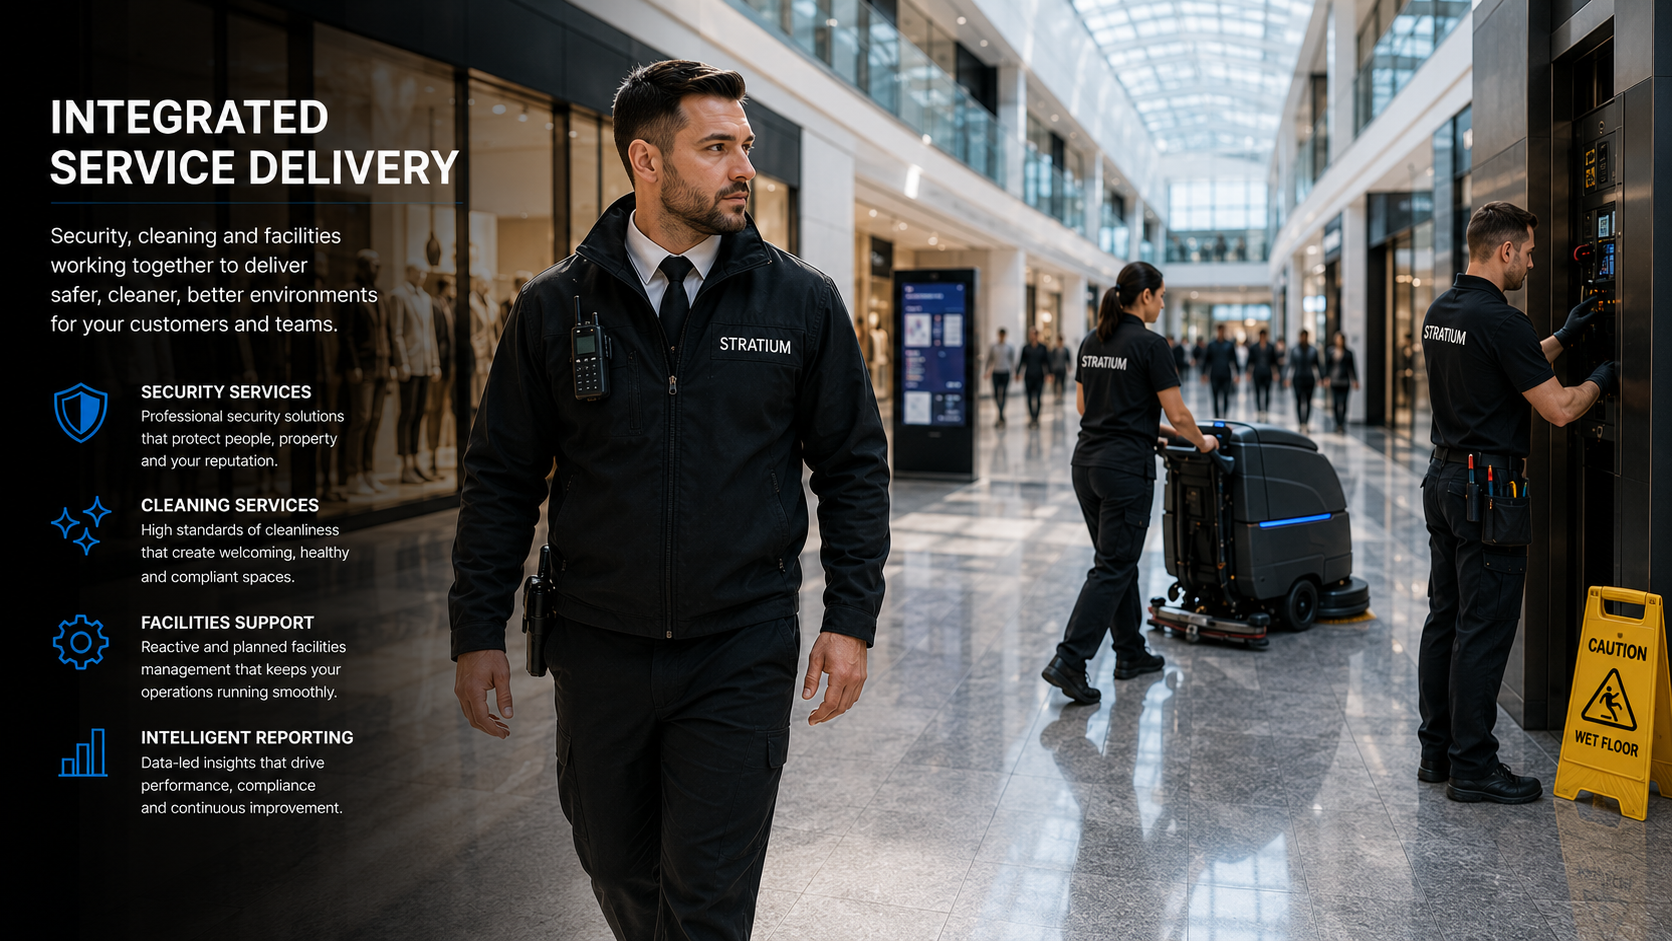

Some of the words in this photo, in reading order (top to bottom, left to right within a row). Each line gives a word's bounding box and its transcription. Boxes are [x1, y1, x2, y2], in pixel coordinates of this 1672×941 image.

[719, 336, 792, 355] STRATIUM
[1423, 324, 1467, 346] STRATIUM
[1081, 355, 1128, 371] STRATIUM
[1588, 637, 1648, 662] CAUTION
[1575, 729, 1600, 747] WET
[1601, 736, 1639, 758] FLOOR
